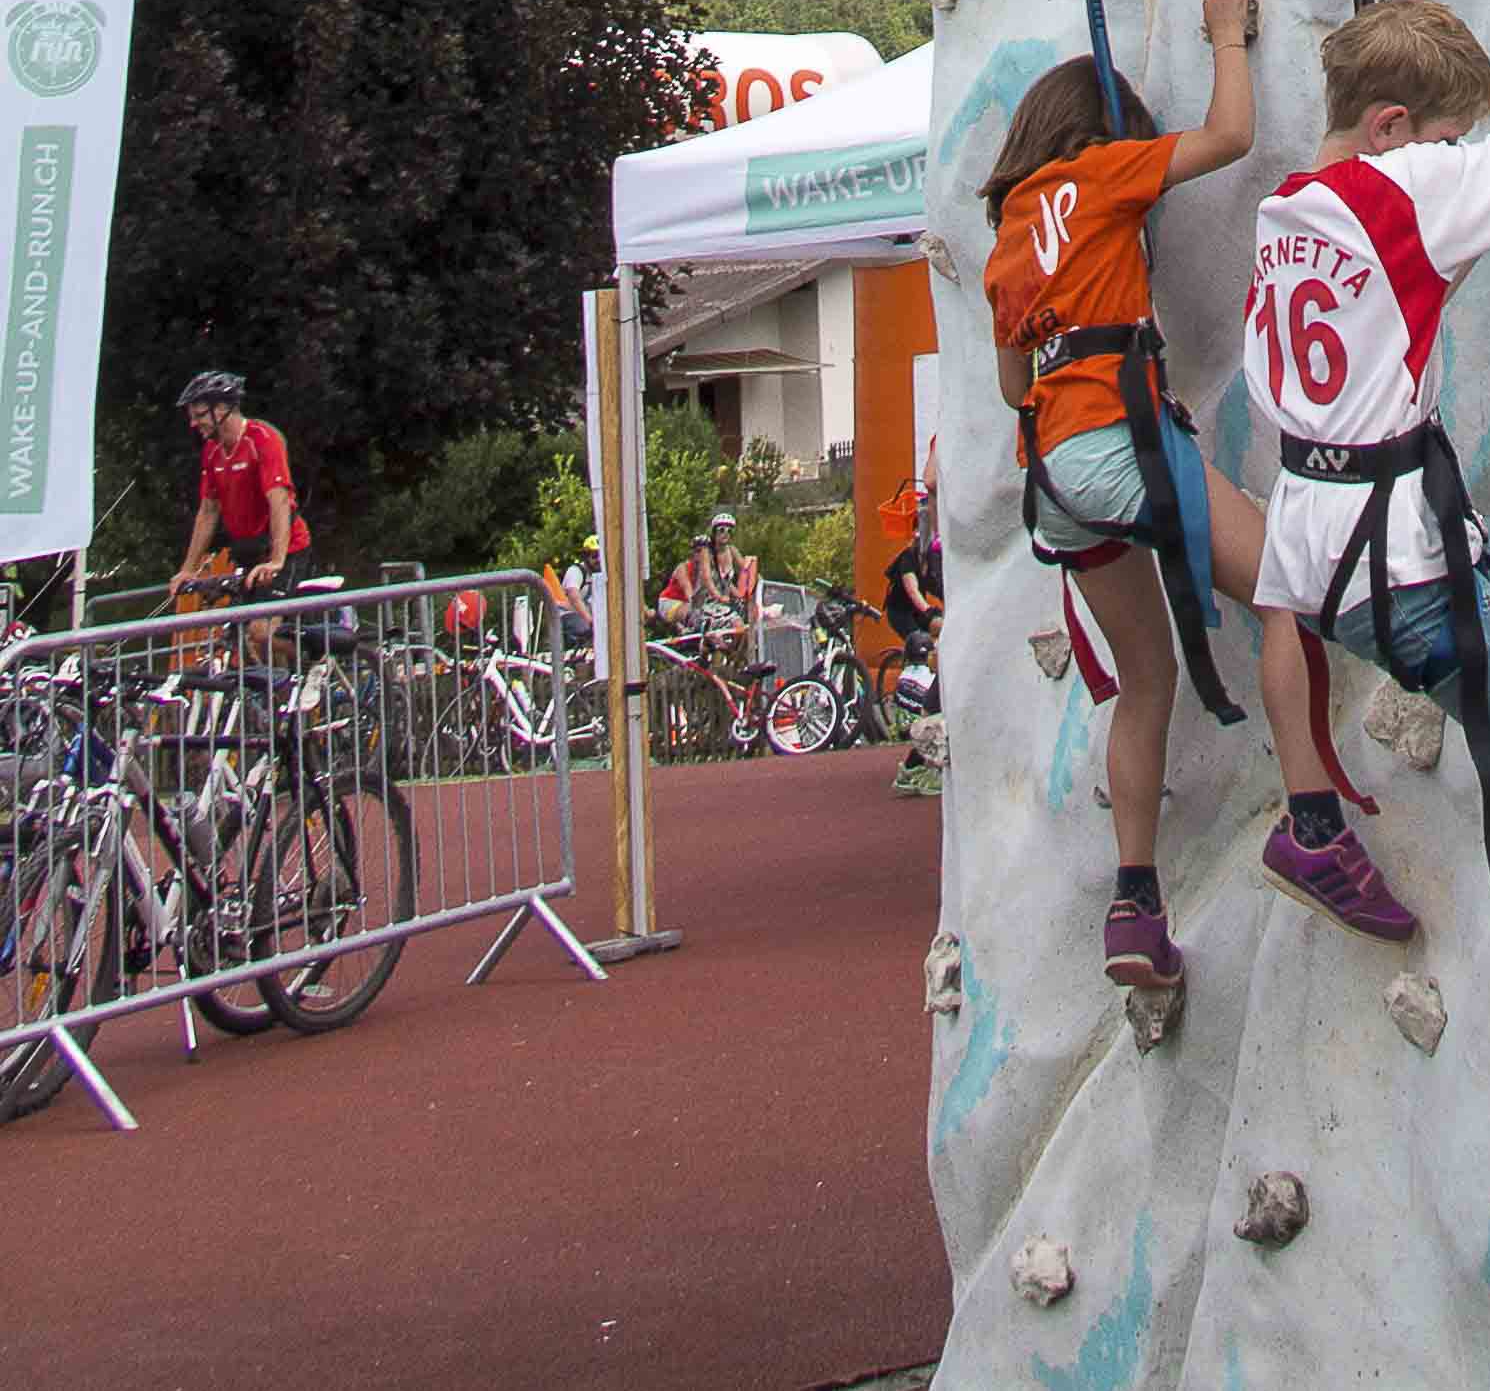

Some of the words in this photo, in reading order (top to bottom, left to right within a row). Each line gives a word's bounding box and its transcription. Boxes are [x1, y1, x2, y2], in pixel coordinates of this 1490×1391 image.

[8, 142, 60, 500] WAKE-UP-AND-RUN.CH
[1252, 235, 1372, 299] ARNETTA
[1255, 277, 1347, 407] 16
